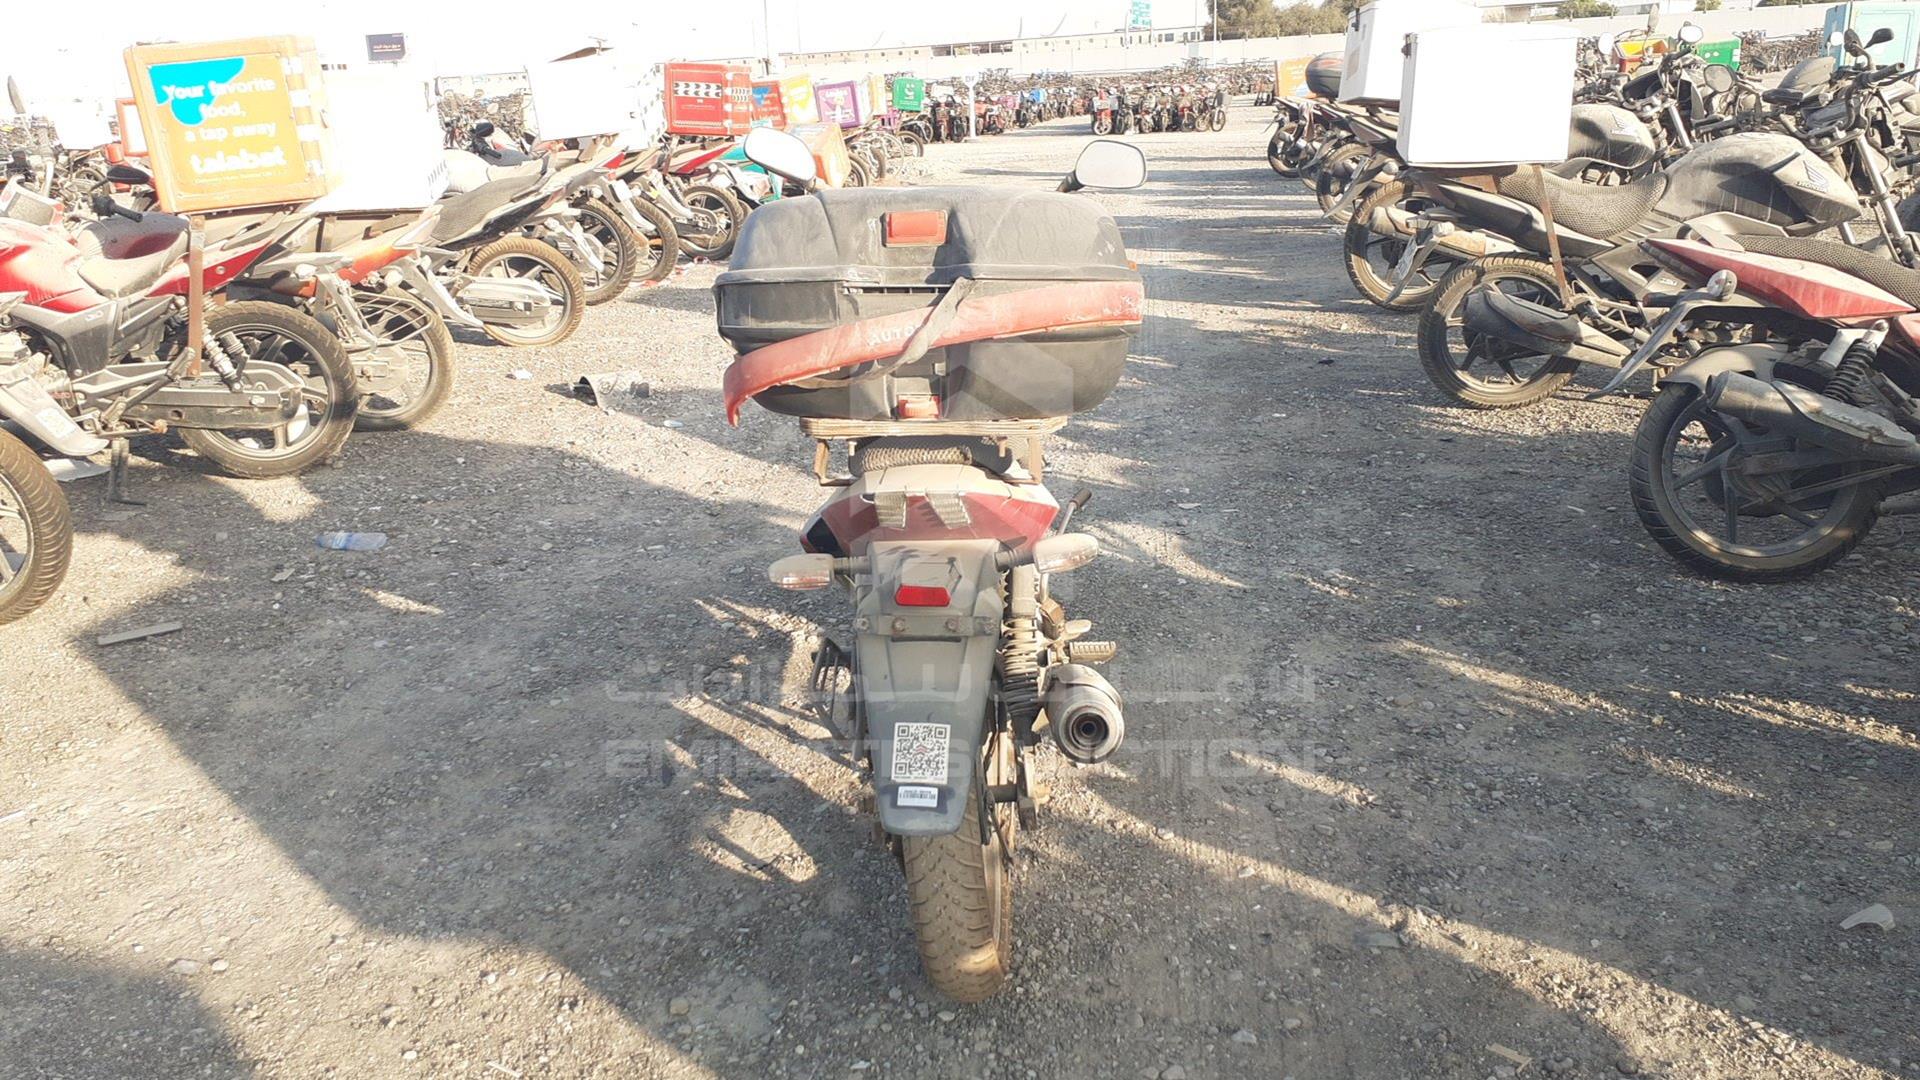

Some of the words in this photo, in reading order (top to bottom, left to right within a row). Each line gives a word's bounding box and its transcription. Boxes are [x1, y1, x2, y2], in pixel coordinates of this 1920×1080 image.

[162, 84, 205, 100] Your
[208, 78, 277, 97] favorite
[200, 101, 246, 117] food,
[186, 130, 196, 142] a
[200, 126, 228, 142] tap
[232, 121, 277, 138] away
[190, 145, 287, 174] talabat
